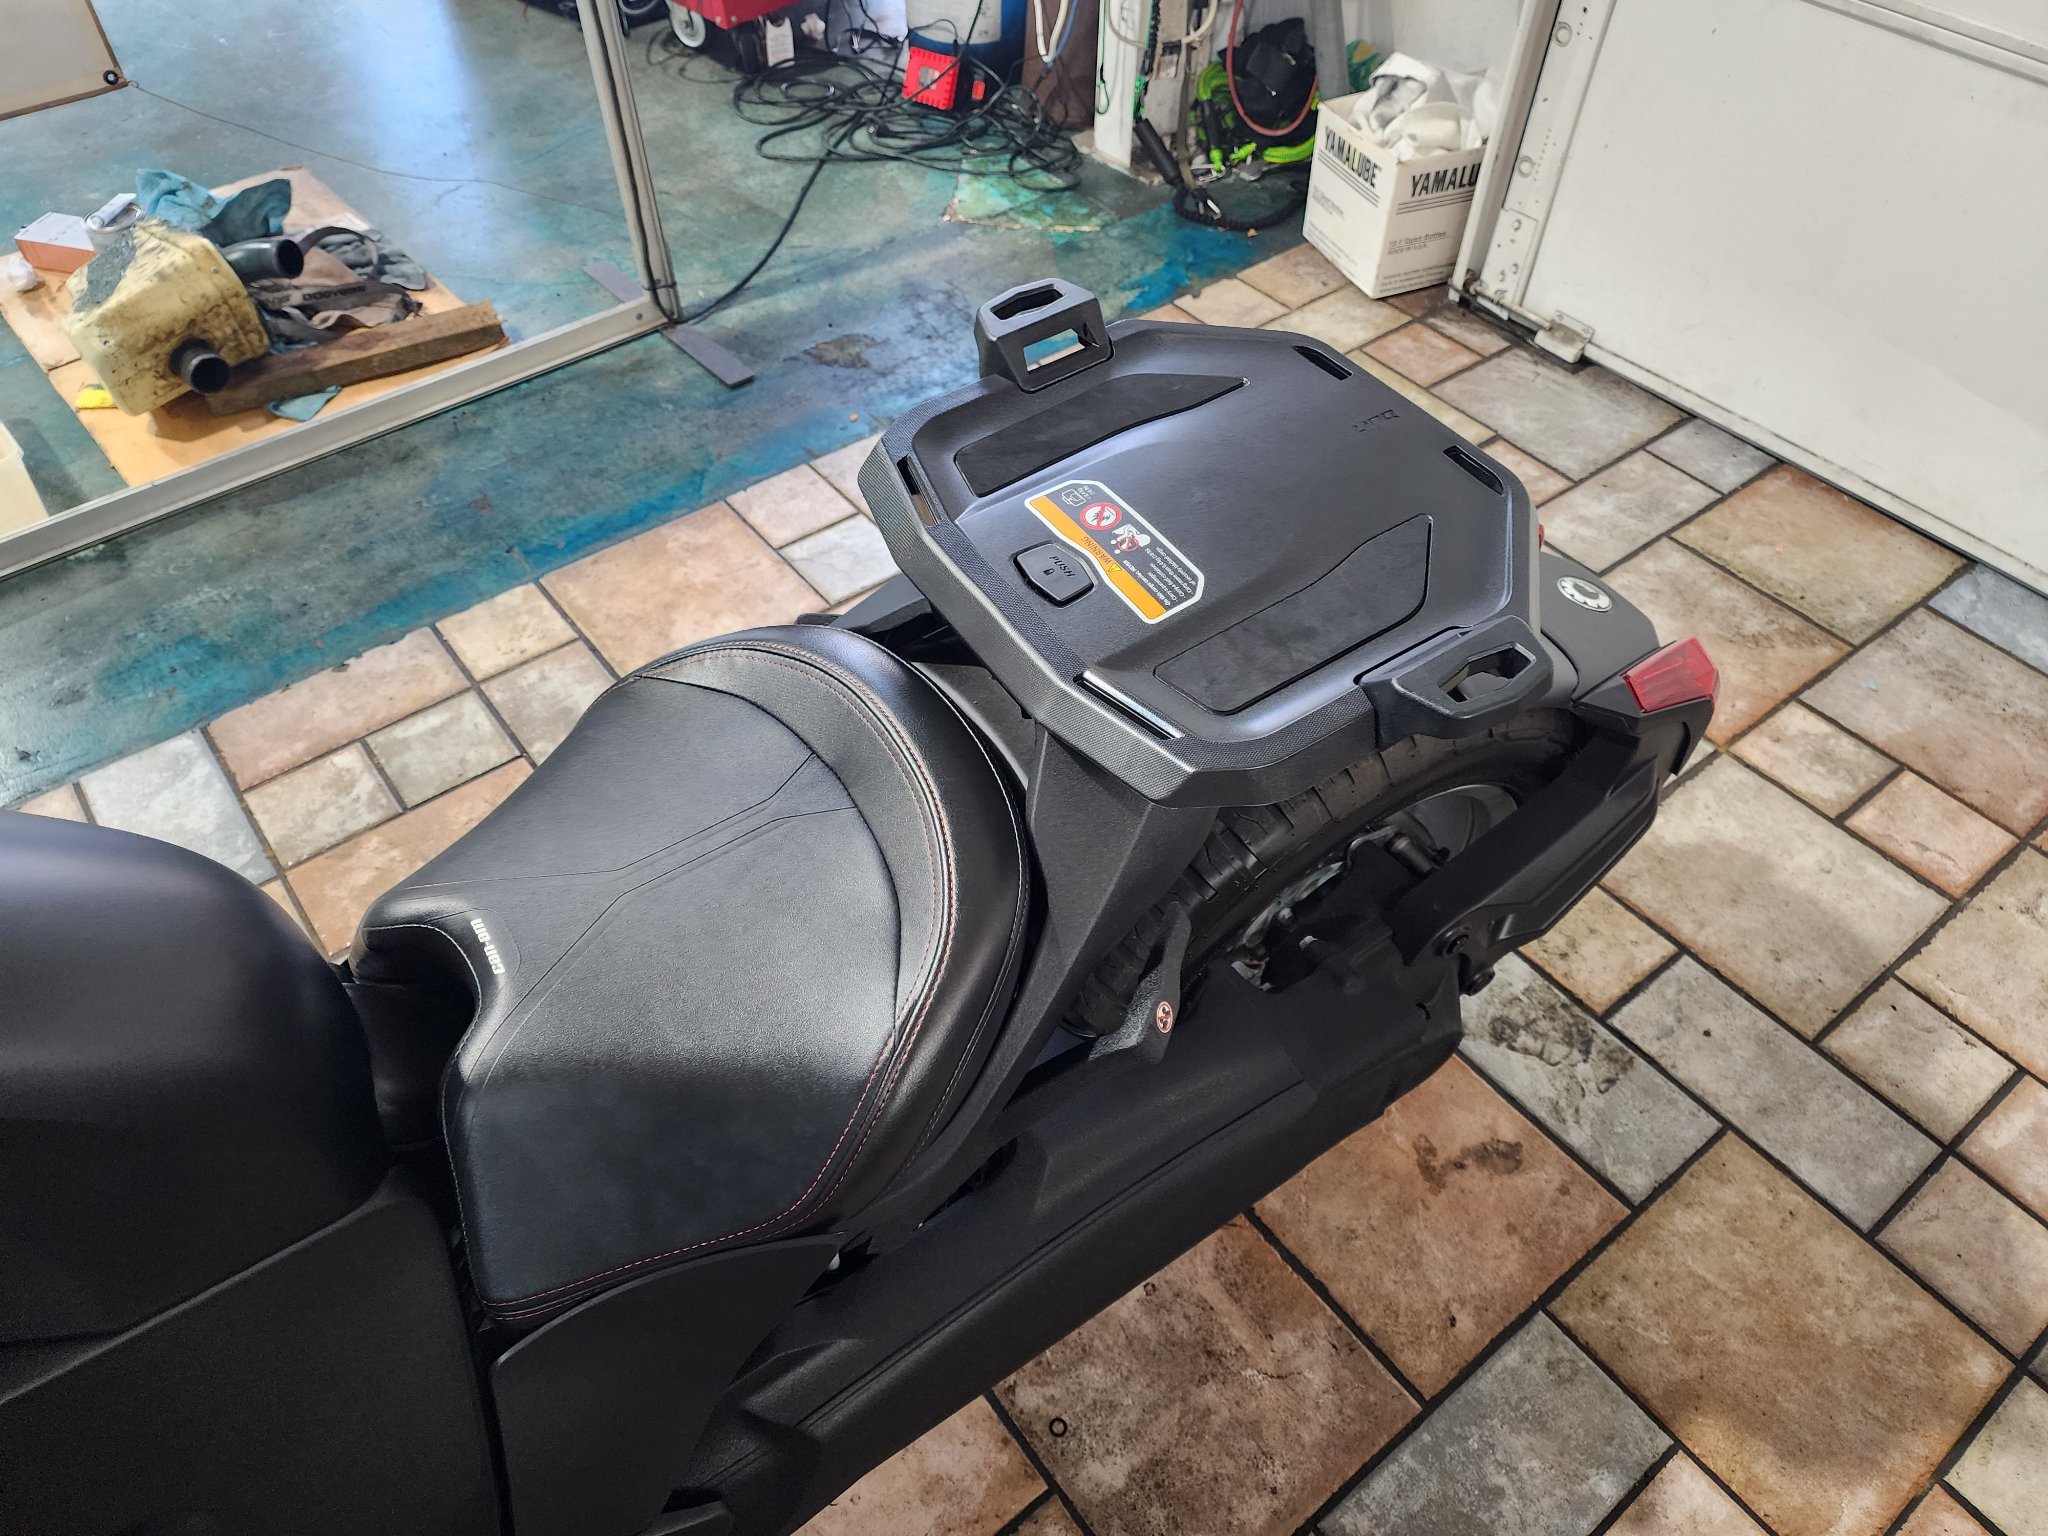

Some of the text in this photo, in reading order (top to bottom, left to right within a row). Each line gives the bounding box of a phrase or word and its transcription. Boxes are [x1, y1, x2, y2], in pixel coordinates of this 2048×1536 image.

[1325, 126, 1378, 188] YAMALUBE
[1049, 555, 1076, 577] PUSH
[1080, 536, 1113, 564] WARNING
[470, 918, 506, 975] can-am
